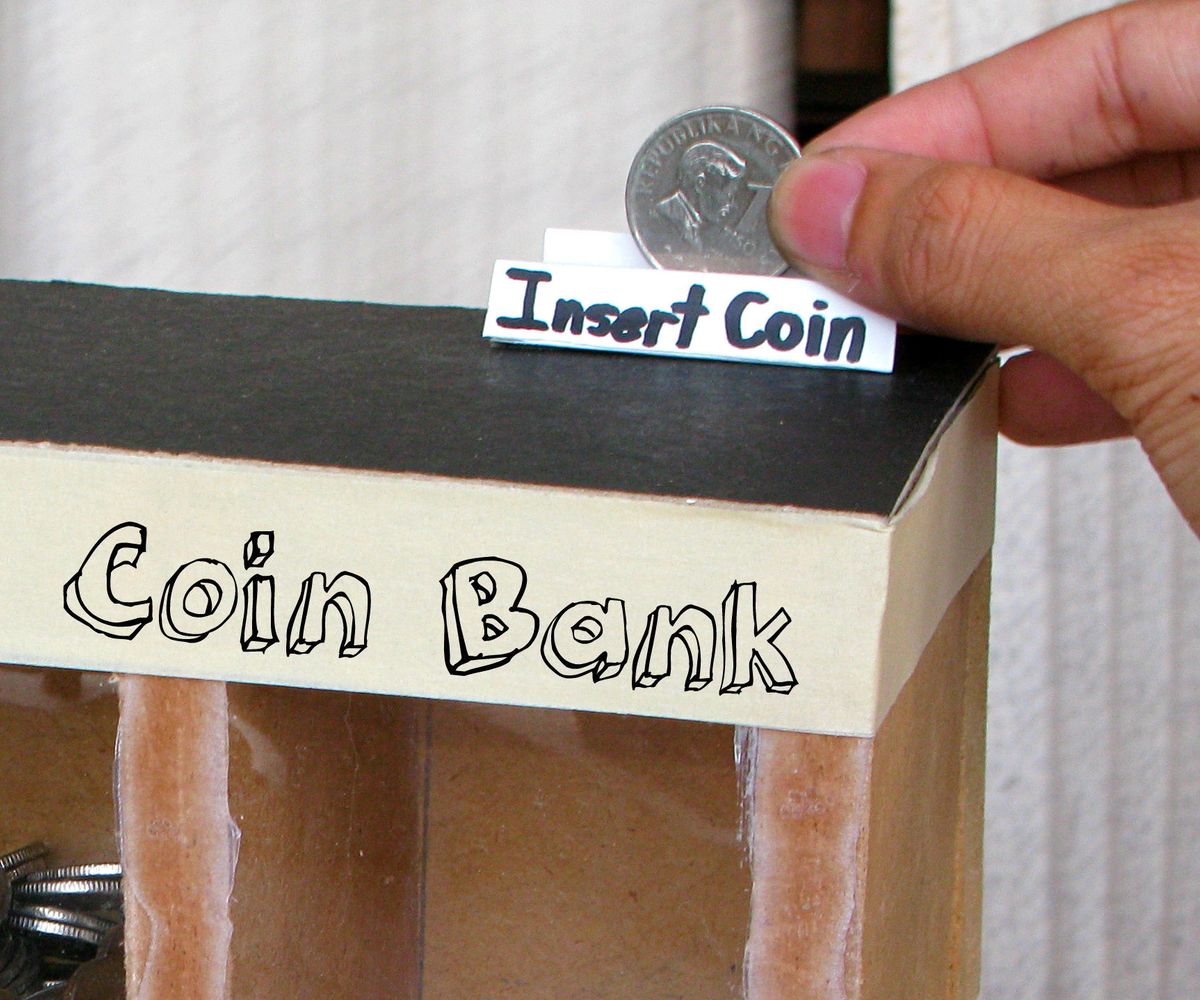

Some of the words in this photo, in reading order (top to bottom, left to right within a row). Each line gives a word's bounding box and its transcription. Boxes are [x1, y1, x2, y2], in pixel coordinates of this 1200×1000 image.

[495, 266, 710, 349] Insert
[724, 290, 867, 364] Coin
[62, 521, 373, 658] Coin
[439, 555, 799, 696] Bank
